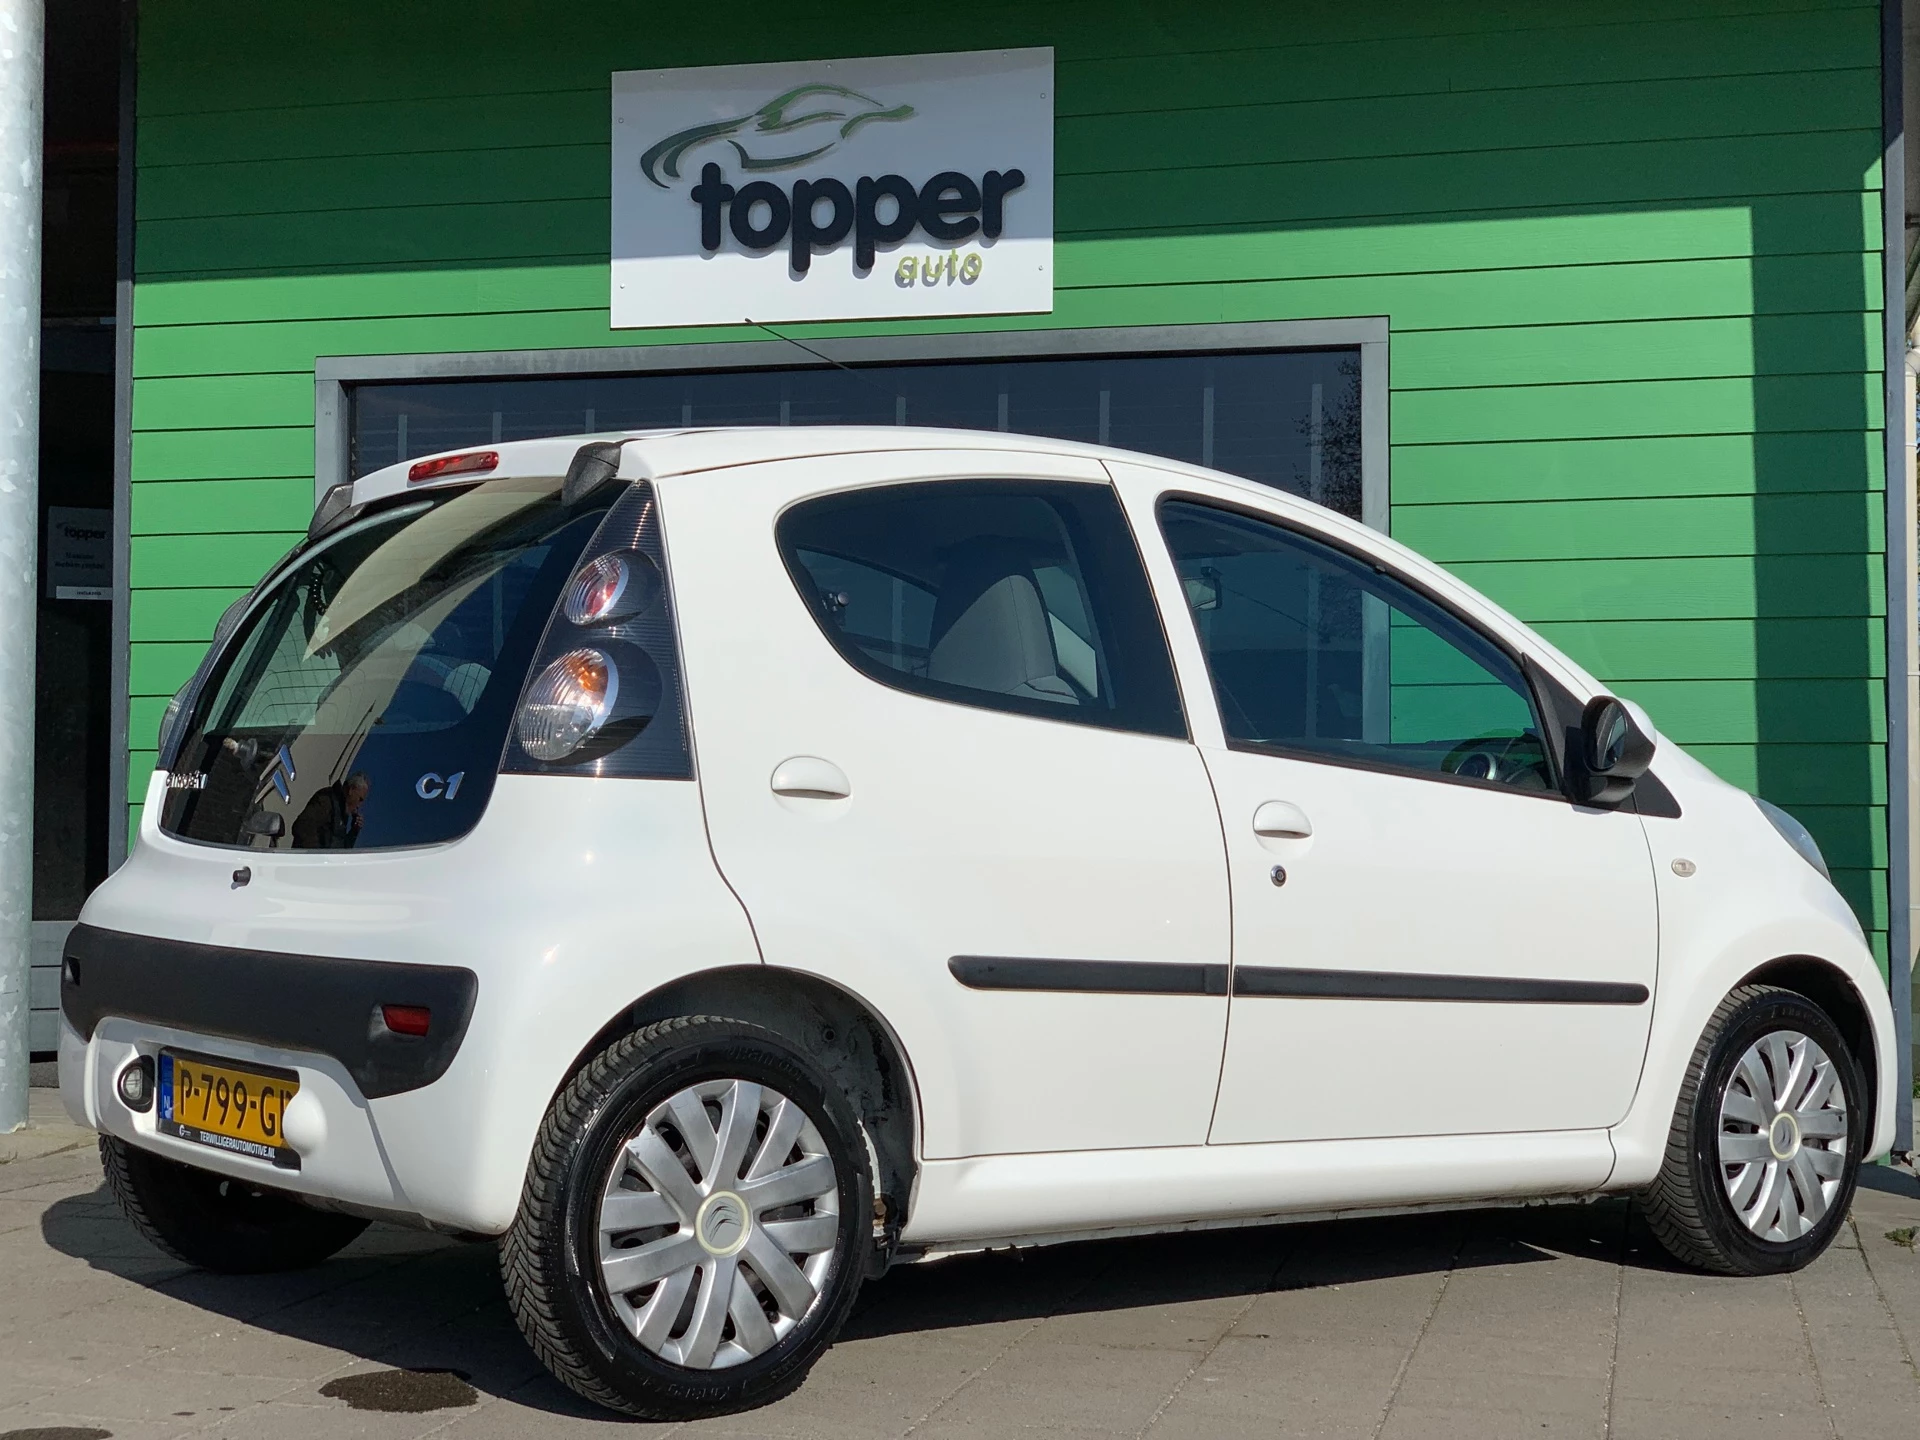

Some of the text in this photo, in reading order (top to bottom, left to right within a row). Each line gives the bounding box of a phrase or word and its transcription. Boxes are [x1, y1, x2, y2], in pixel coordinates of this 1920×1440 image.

[690, 161, 1026, 272] topper
[897, 247, 983, 280] auto
[415, 771, 465, 800] C1
